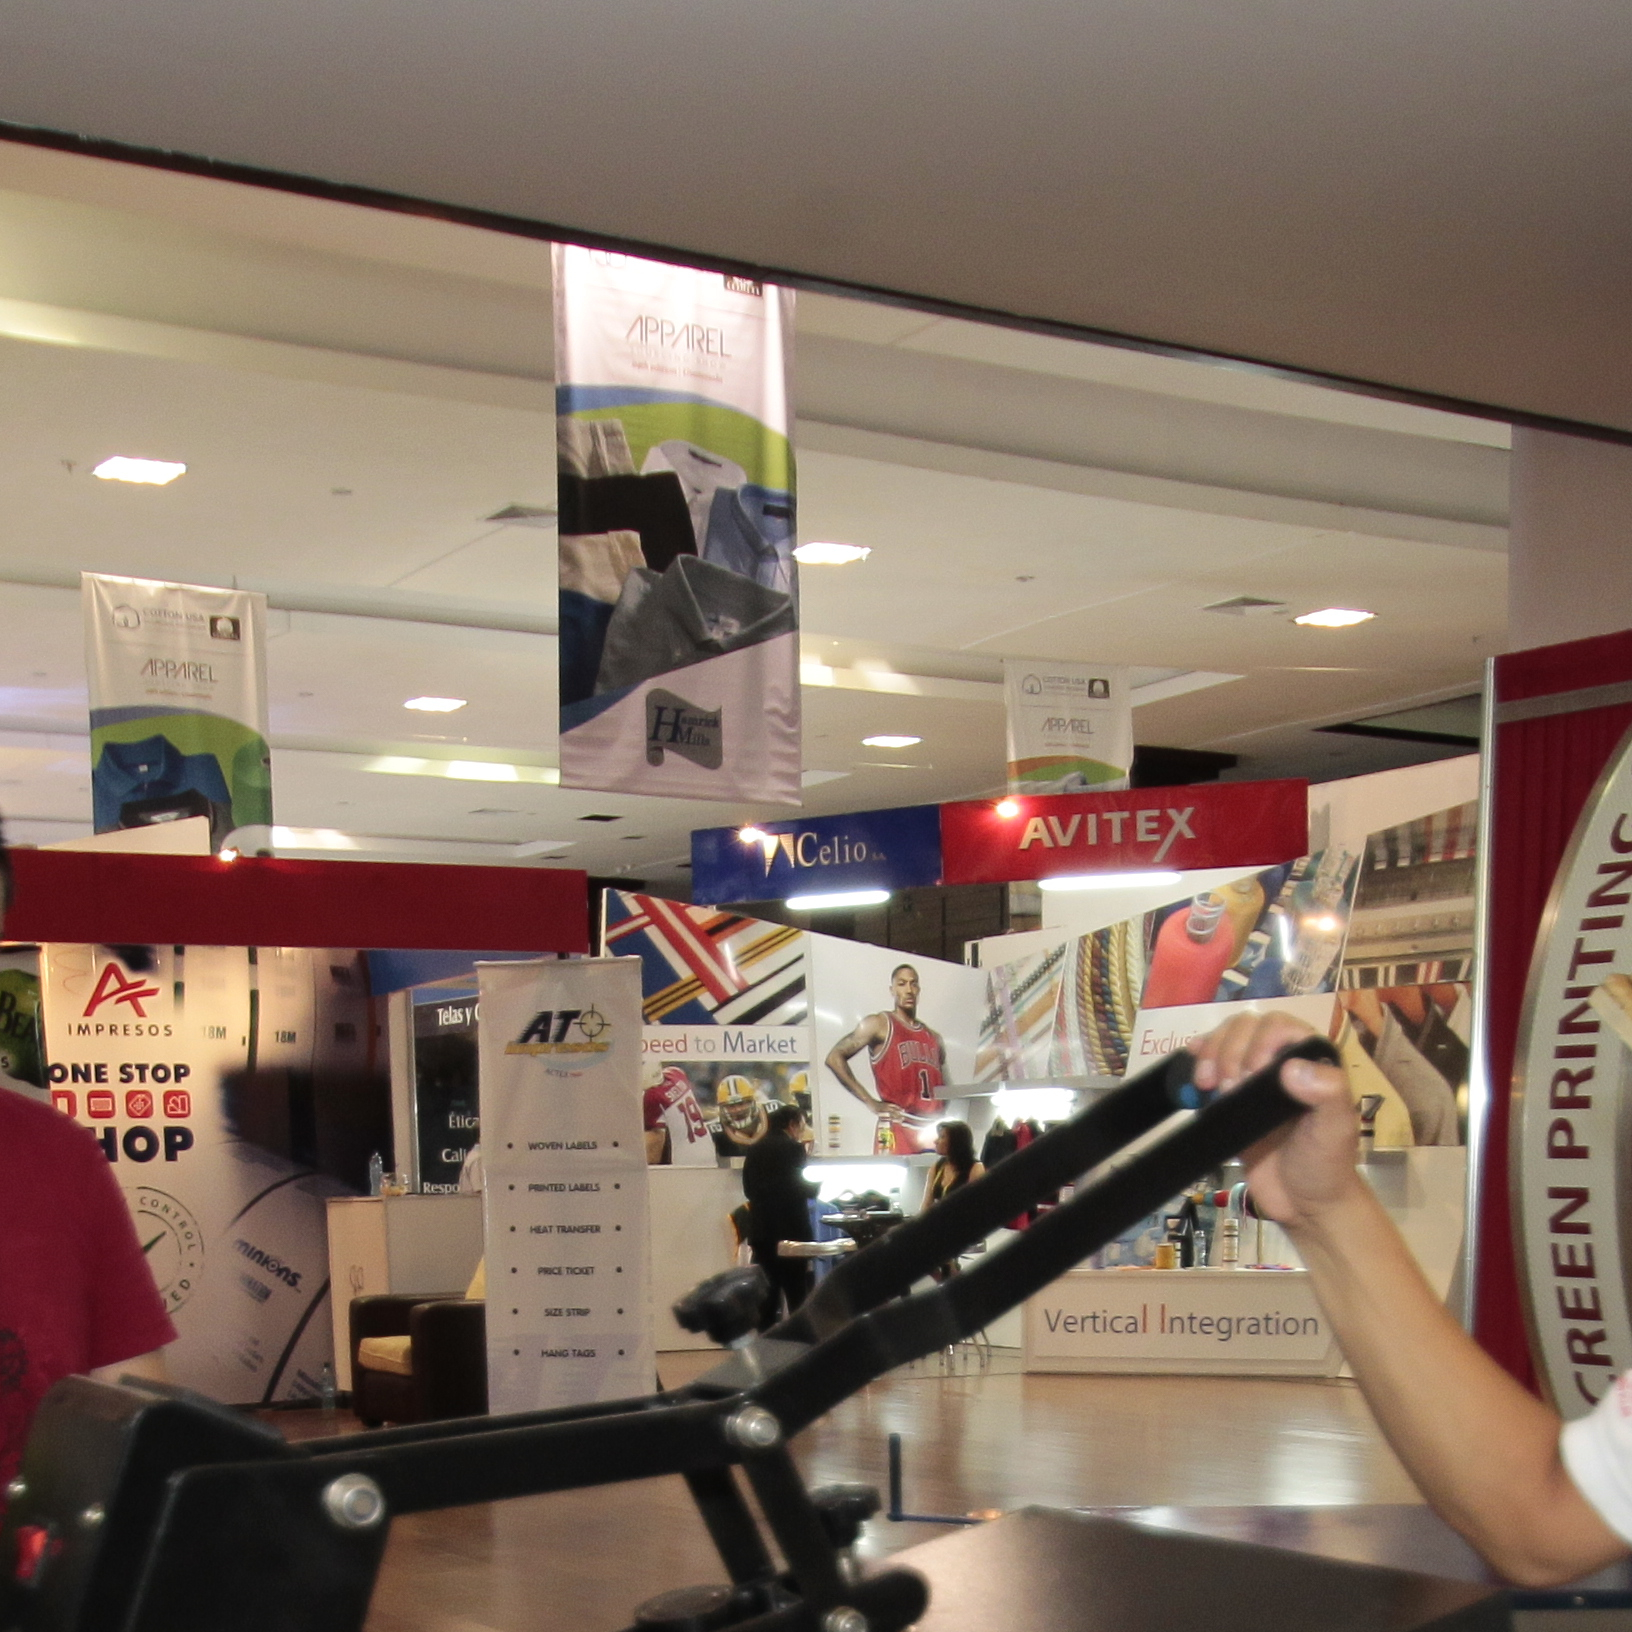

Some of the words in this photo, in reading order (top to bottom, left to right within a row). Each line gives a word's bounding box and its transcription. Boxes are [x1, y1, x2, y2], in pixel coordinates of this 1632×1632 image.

[625, 314, 733, 358] APPAREL
[140, 658, 219, 683] APPAREL
[1041, 716, 1095, 735] APPAREL
[1018, 806, 1196, 864] AVITEX
[796, 831, 868, 868] Celio
[437, 1006, 464, 1026] Telas
[67, 1023, 174, 1037] IMPRESOS
[275, 1030, 297, 1044] 18M
[694, 1036, 716, 1053] to
[723, 1031, 798, 1054] Market
[48, 1063, 109, 1083] ONE
[119, 1062, 191, 1084] STOP
[528, 1141, 564, 1151] WOVEN
[565, 1141, 598, 1150] LABELS
[528, 1183, 566, 1193] PRINTED
[568, 1183, 601, 1192] LABELS
[139, 1196, 197, 1251] CONTROL
[530, 1225, 554, 1234] HEAT
[556, 1224, 601, 1234] TRANSFER
[537, 1266, 563, 1276] PRICE
[565, 1266, 595, 1276] TICKET
[544, 1308, 564, 1317] SIZE
[566, 1308, 591, 1317] STRIP
[1044, 1303, 1147, 1334] Vertical
[1160, 1303, 1319, 1342] Integration
[541, 1348, 569, 1358] HANG
[571, 1348, 596, 1358] TAGS
